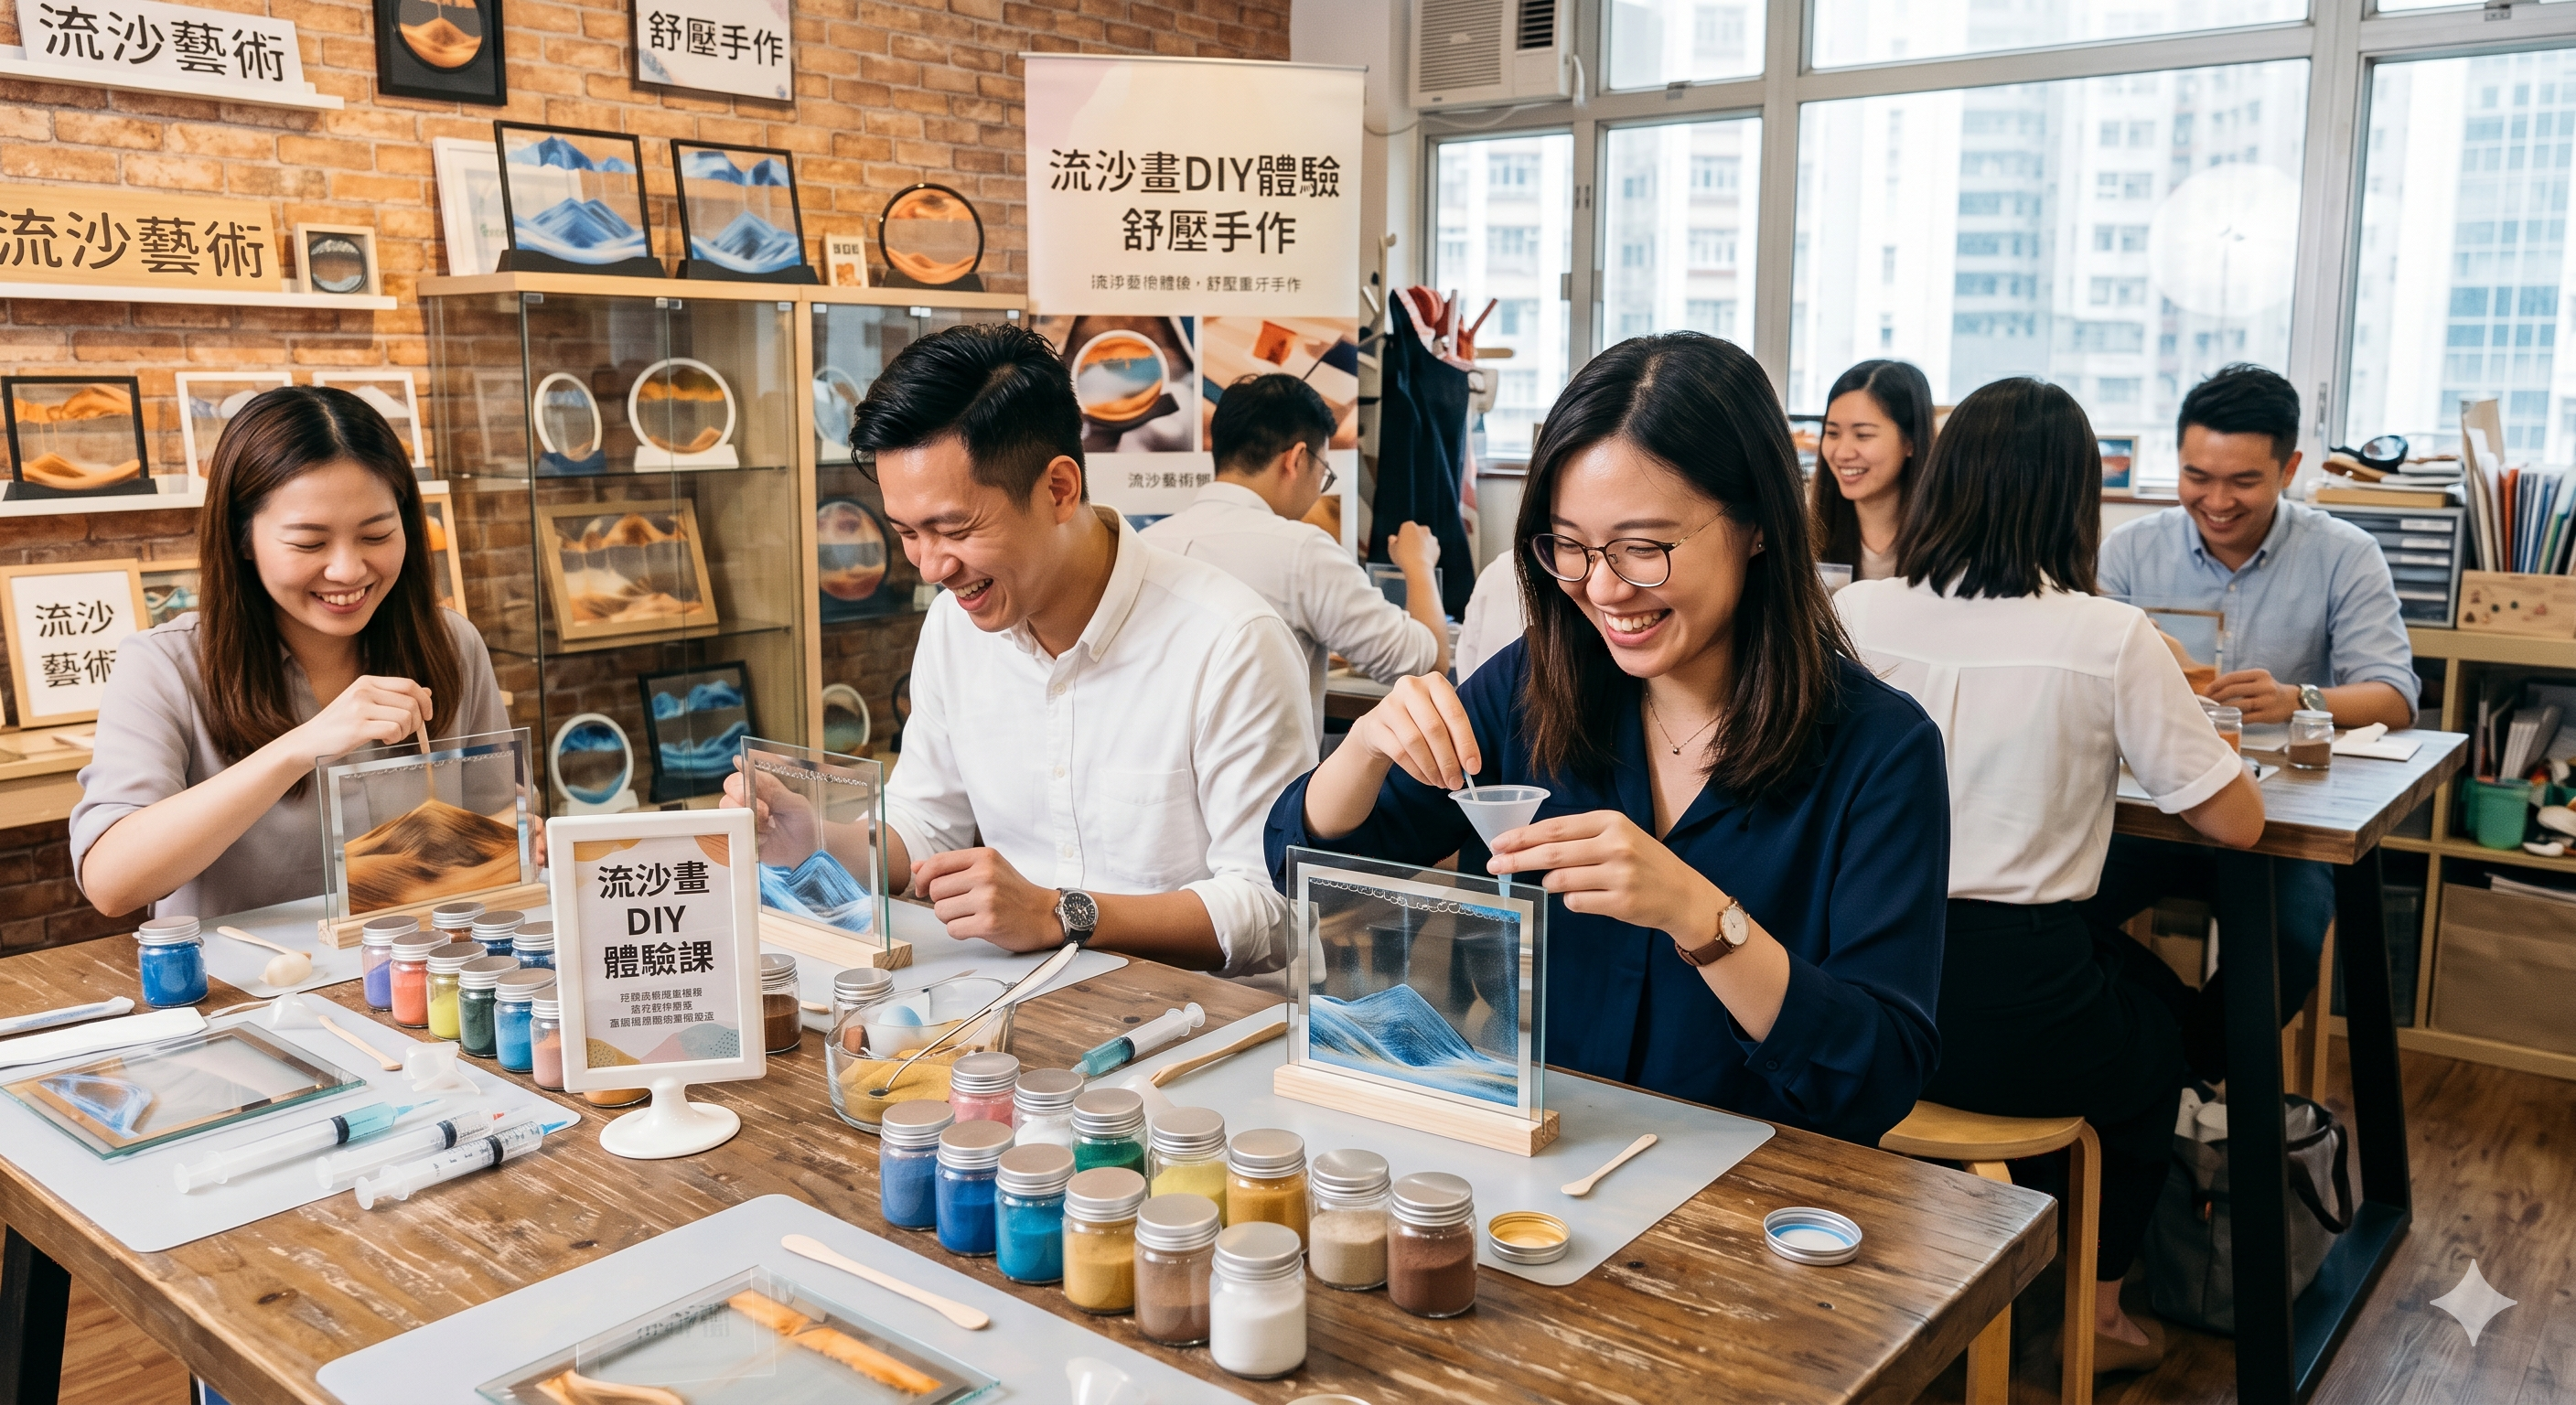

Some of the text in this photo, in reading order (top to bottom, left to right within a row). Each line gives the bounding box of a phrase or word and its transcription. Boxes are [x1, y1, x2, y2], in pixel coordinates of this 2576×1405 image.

[39, 3, 284, 82] 流沙藝術
[649, 11, 783, 66] 舒壓手作
[1049, 148, 1340, 198] 流沙畫DIY體驗
[0, 208, 264, 278] 流沙藝術
[1122, 208, 1296, 253] 舒壓手作
[36, 600, 114, 638] 流沙
[41, 649, 117, 688] 藝術
[597, 860, 710, 899] 流沙畫
[627, 905, 686, 936] DIY
[604, 940, 714, 980] 體驗課
